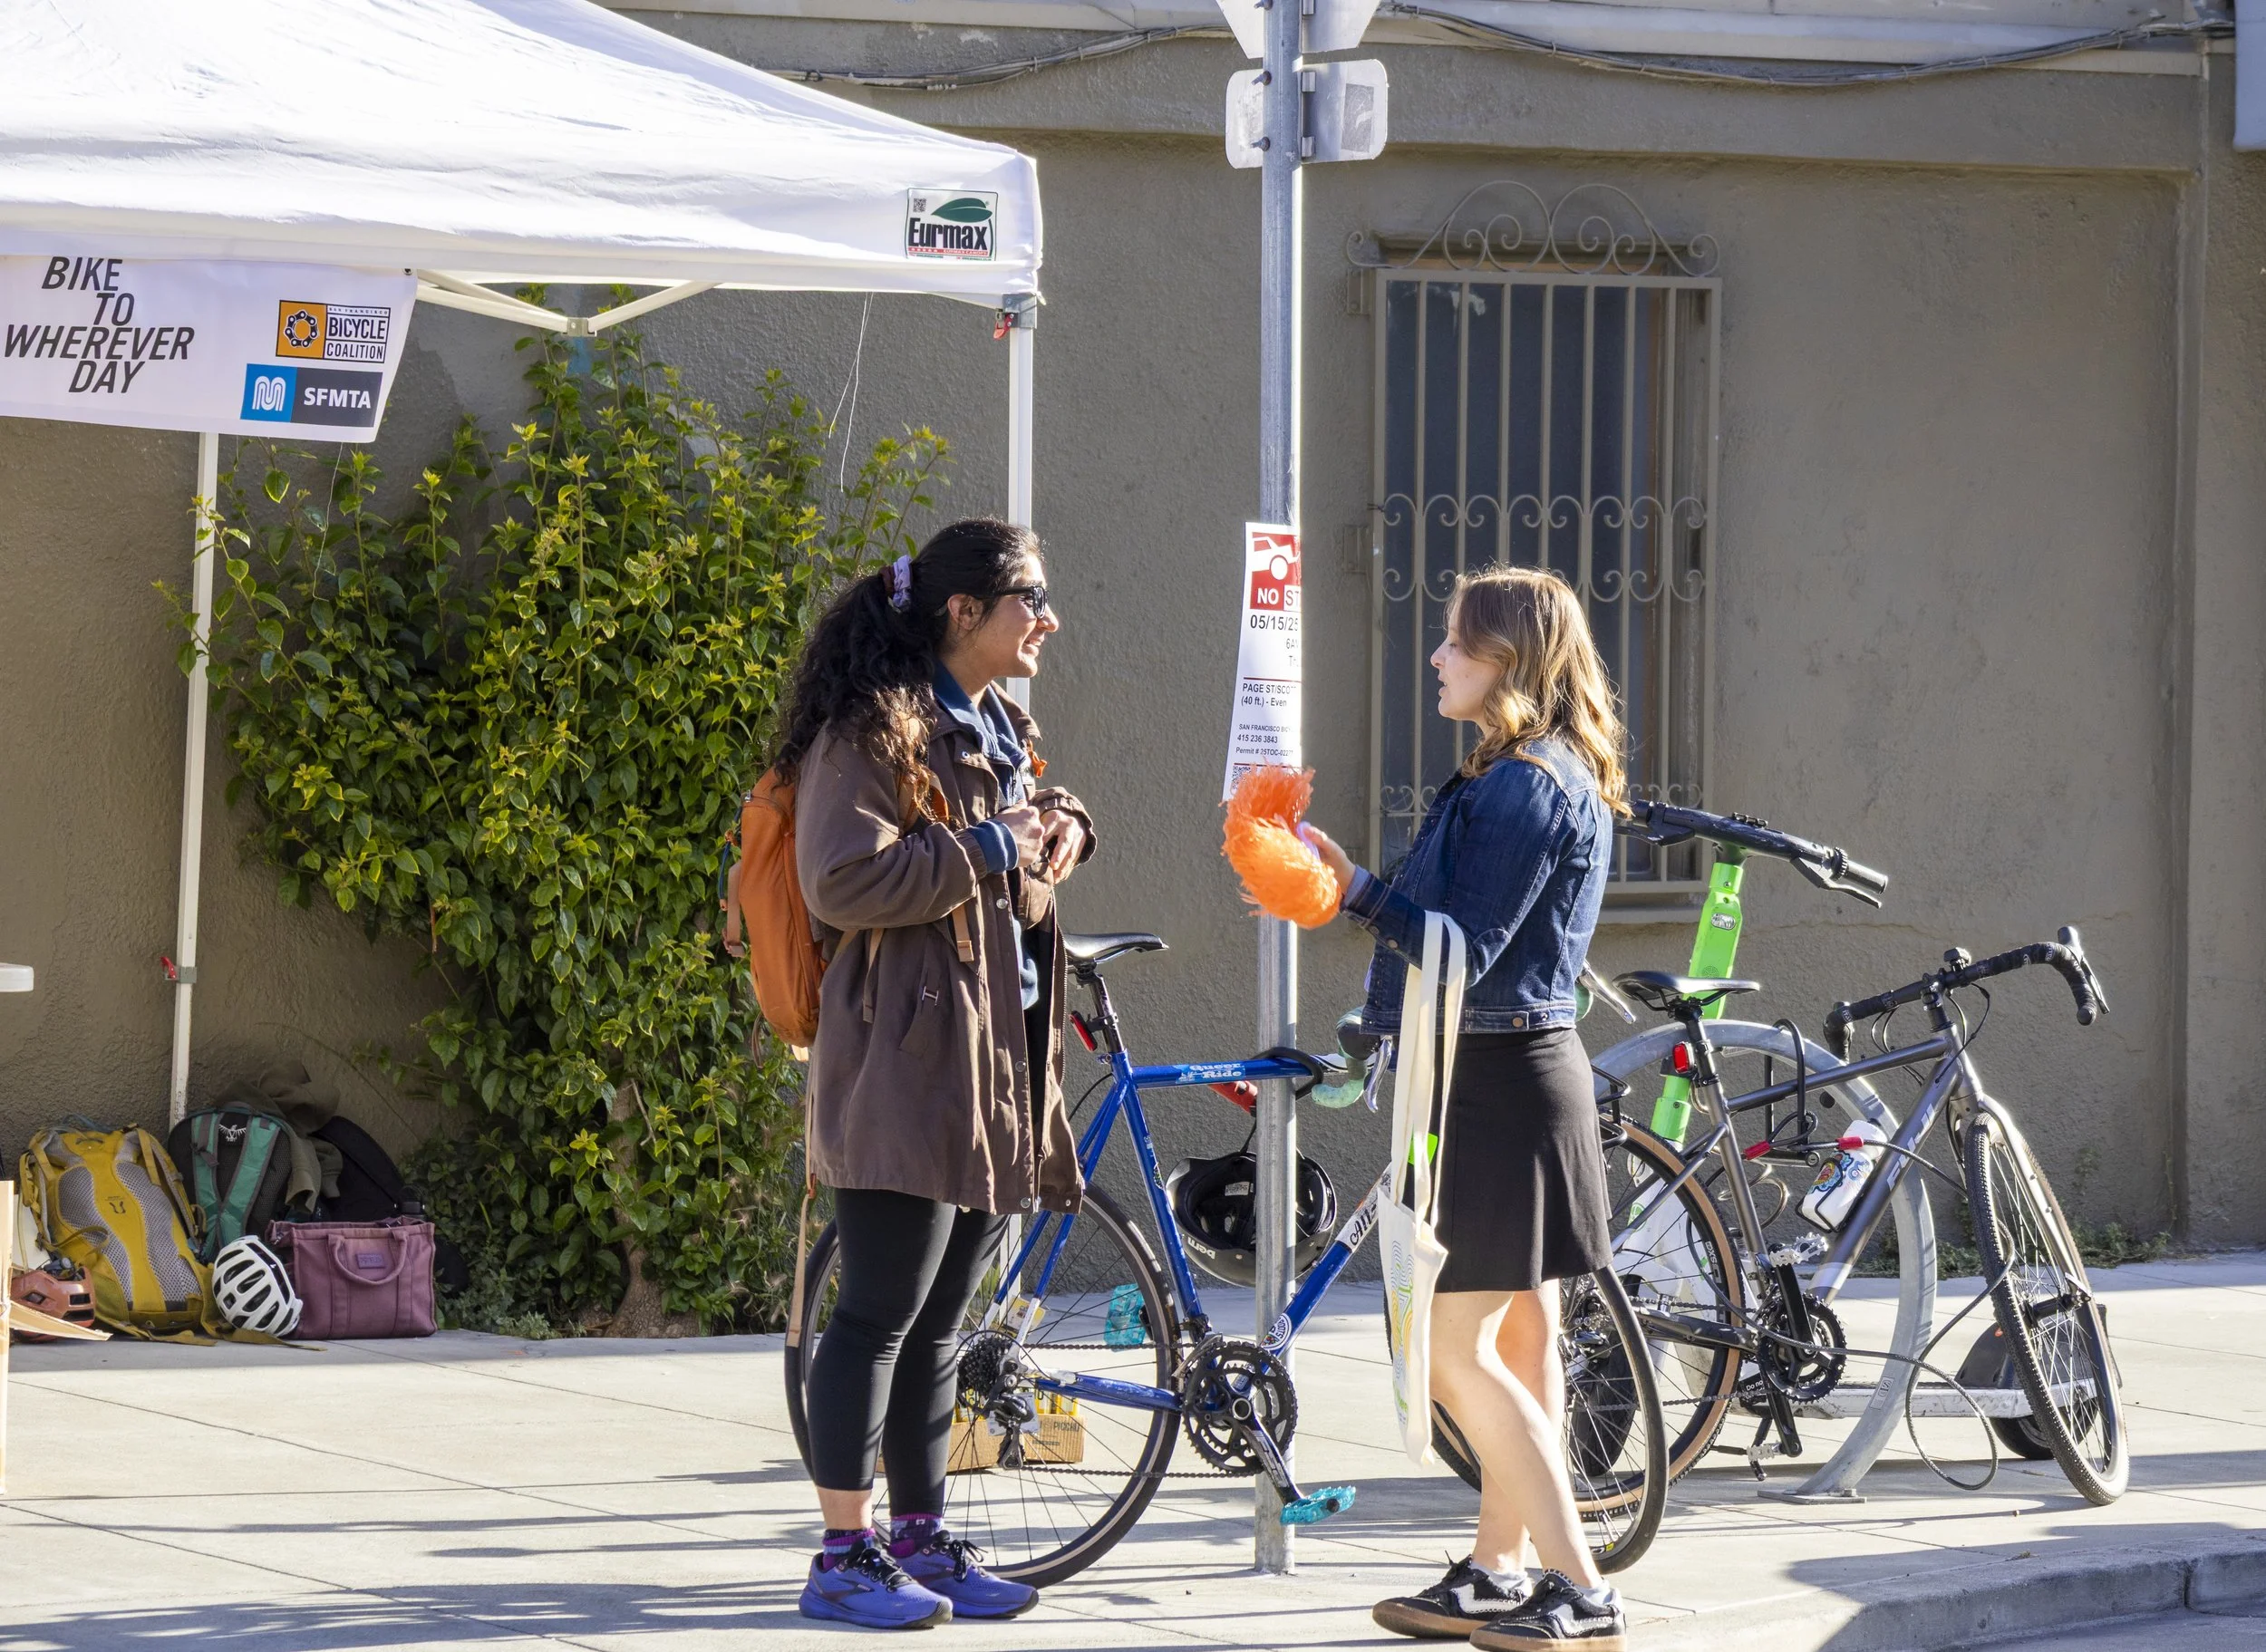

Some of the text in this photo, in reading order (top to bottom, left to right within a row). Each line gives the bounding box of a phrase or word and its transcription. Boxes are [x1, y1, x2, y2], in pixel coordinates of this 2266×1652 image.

[908, 217, 988, 250] Eurmax
[42, 256, 123, 291] BIKE
[92, 293, 135, 326] TO
[328, 316, 387, 340] BICYCLE
[5, 324, 195, 361] WHEREVER
[326, 343, 383, 360] COALITION
[68, 360, 145, 393] DAY
[304, 387, 372, 409] SFMTA
[1257, 587, 1279, 605] NO
[1243, 682, 1264, 693] PAGE
[1241, 696, 1253, 707] (40
[1254, 696, 1264, 708] ft.)
[1270, 697, 1287, 707] Even
[1251, 724, 1281, 732] FRANCISCO
[1264, 735, 1278, 743] 3843
[1235, 747, 1254, 755] Permit
[1203, 1070, 1243, 1078] Ride
[1886, 1103, 1934, 1192] FUJI
